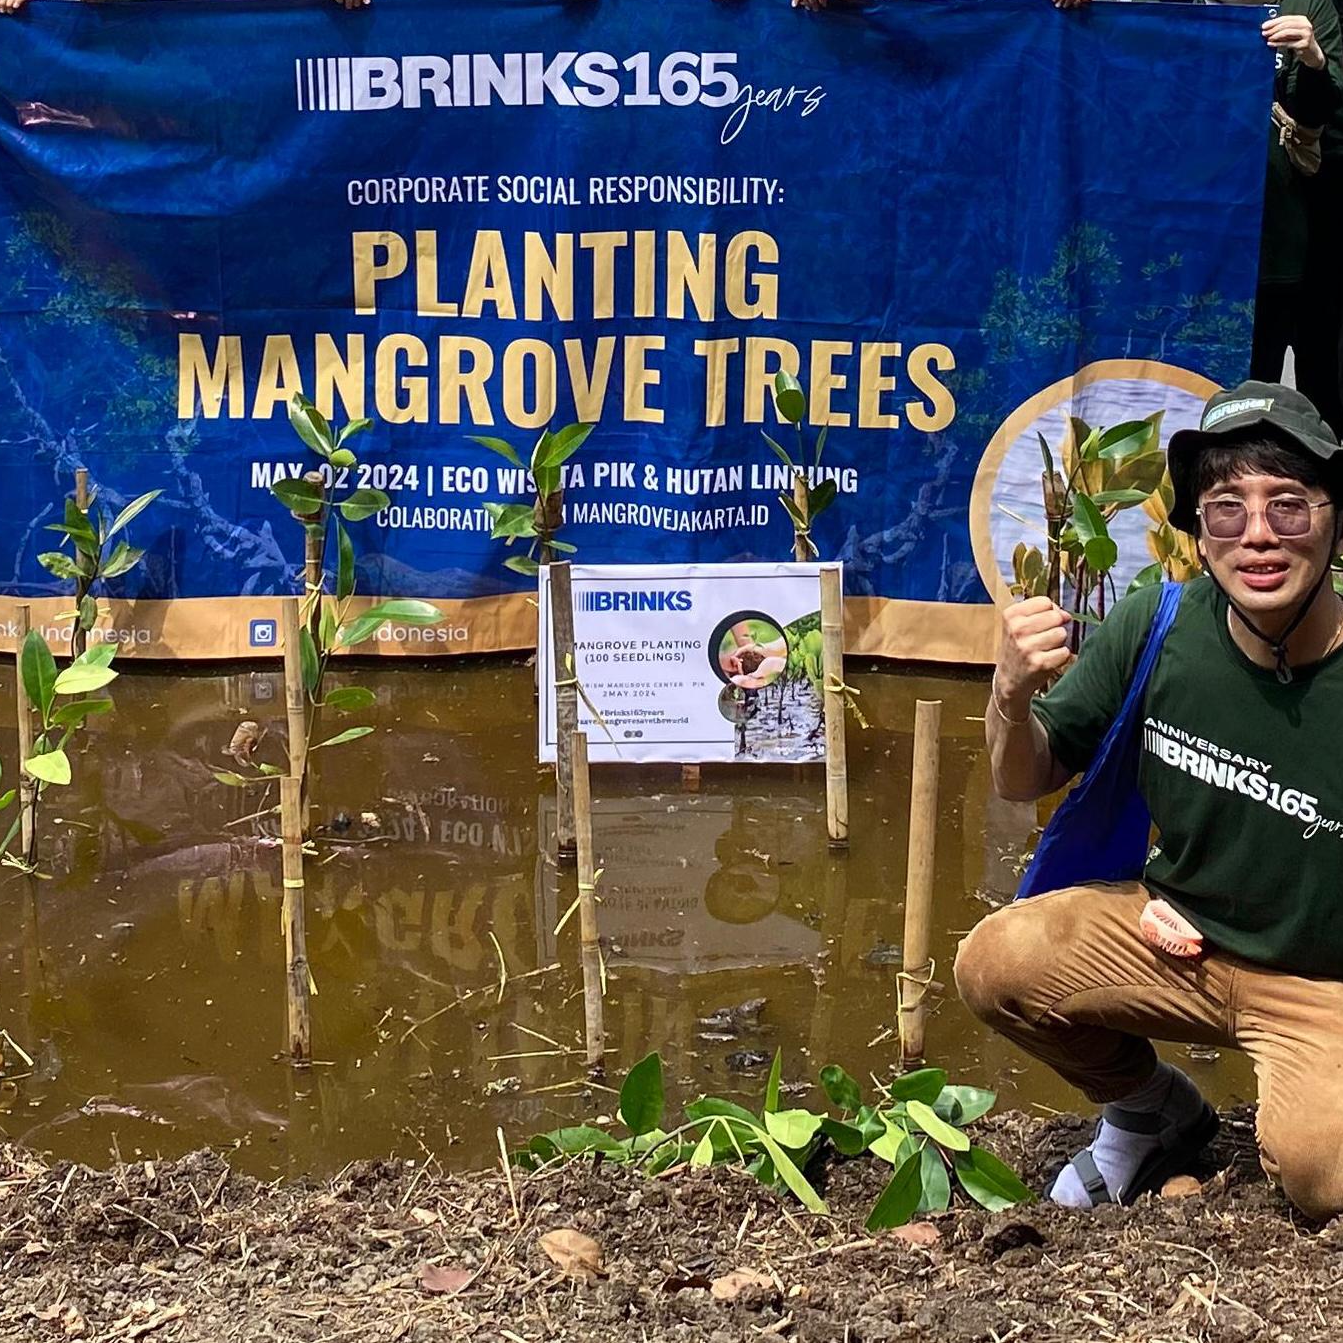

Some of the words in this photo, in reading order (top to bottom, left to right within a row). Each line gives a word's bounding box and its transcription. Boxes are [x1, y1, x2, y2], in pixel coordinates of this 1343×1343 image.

[720, 81, 826, 145] years
[347, 175, 491, 206] CORPORATE
[497, 174, 582, 205] SOCIAL
[588, 176, 785, 206] RESPONSIBILITY:
[351, 229, 779, 322] PLANTING
[176, 332, 666, 430] MANGROVE
[693, 337, 956, 432] TREES
[356, 463, 420, 492] 2024
[441, 465, 490, 494] ECO
[593, 461, 638, 490] PIK
[642, 463, 659, 492] &
[665, 464, 744, 495] HUTAN
[573, 502, 770, 534] MANGROVEJAKARTA.ID
[593, 589, 693, 612] BRINKS
[585, 653, 609, 665] (100
[613, 652, 686, 664] SEEDLINGS)
[641, 640, 702, 650] PLANTING
[1144, 716, 1273, 774] ANNIVERSARY
